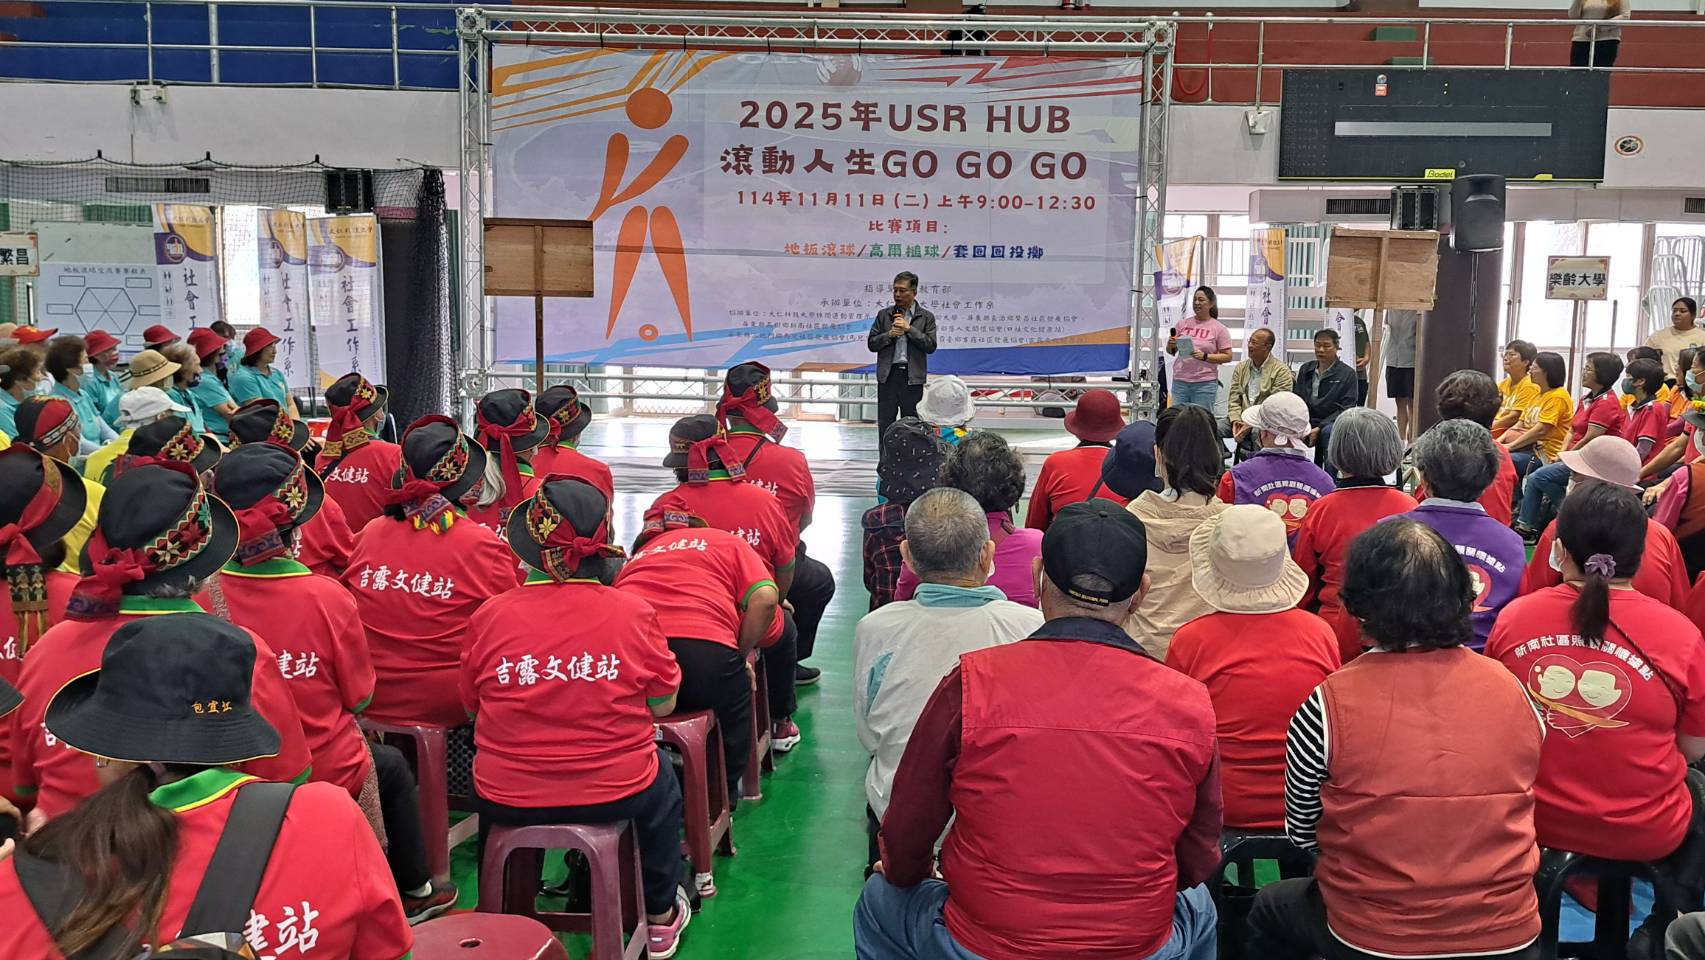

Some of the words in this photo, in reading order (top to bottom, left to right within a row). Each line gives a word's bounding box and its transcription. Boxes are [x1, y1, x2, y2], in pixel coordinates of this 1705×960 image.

[739, 100, 967, 133] 2025年USR
[986, 104, 1072, 133] HUB
[719, 144, 938, 179] 滾動人生GO
[955, 149, 1013, 180] GO
[1029, 150, 1088, 181] GO
[0, 248, 29, 266] 繁昌
[1549, 272, 1606, 287] 樂齡大學
[318, 465, 370, 484] 文健站
[360, 564, 455, 600] 吉露文健站
[496, 653, 621, 687] 吉露文健站
